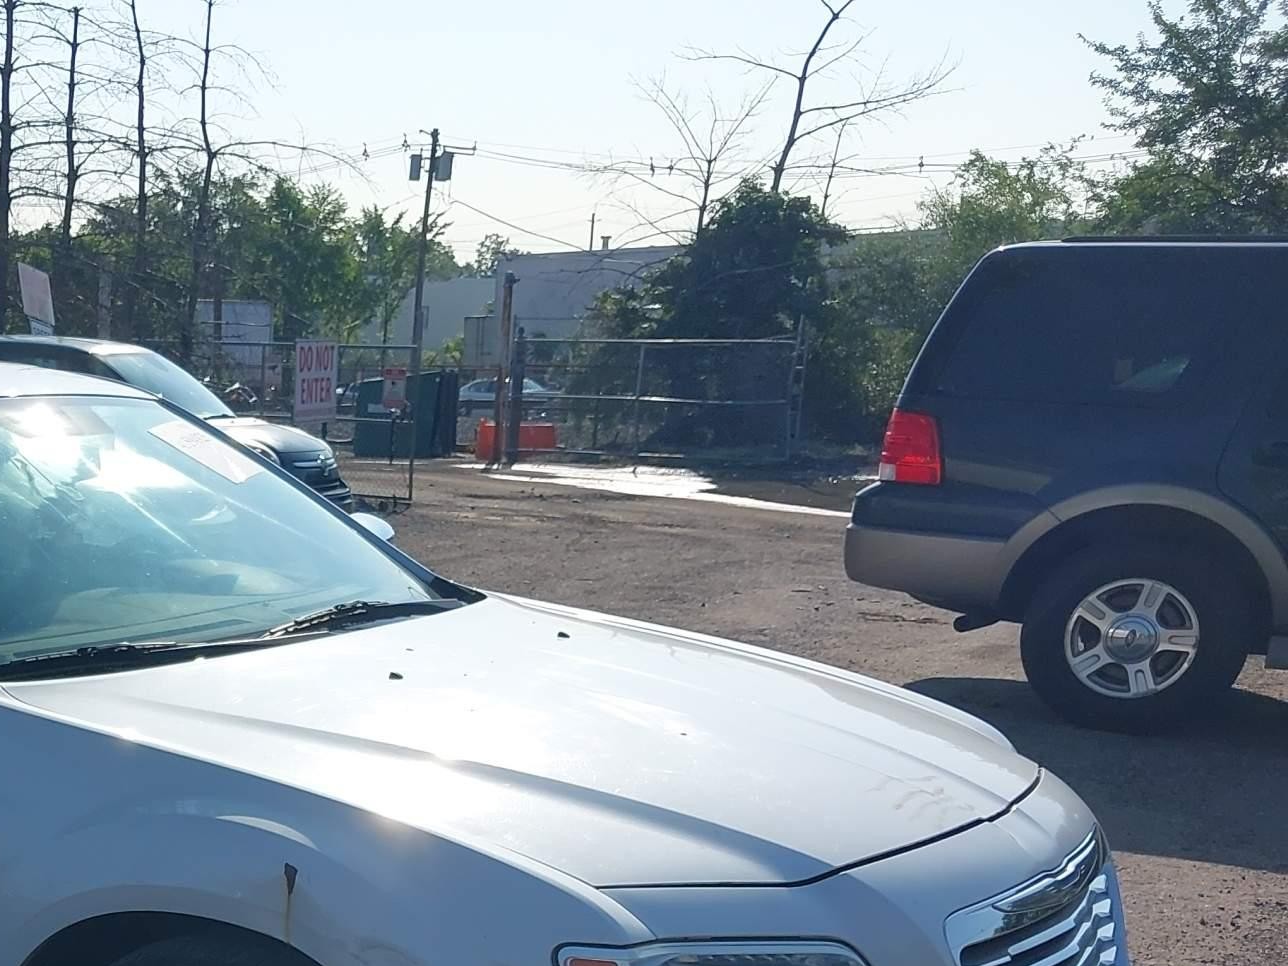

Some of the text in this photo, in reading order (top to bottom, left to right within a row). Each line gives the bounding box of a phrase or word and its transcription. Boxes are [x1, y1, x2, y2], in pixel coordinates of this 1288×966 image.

[299, 345, 335, 373] DO NOT
[301, 377, 332, 404] ENTER
